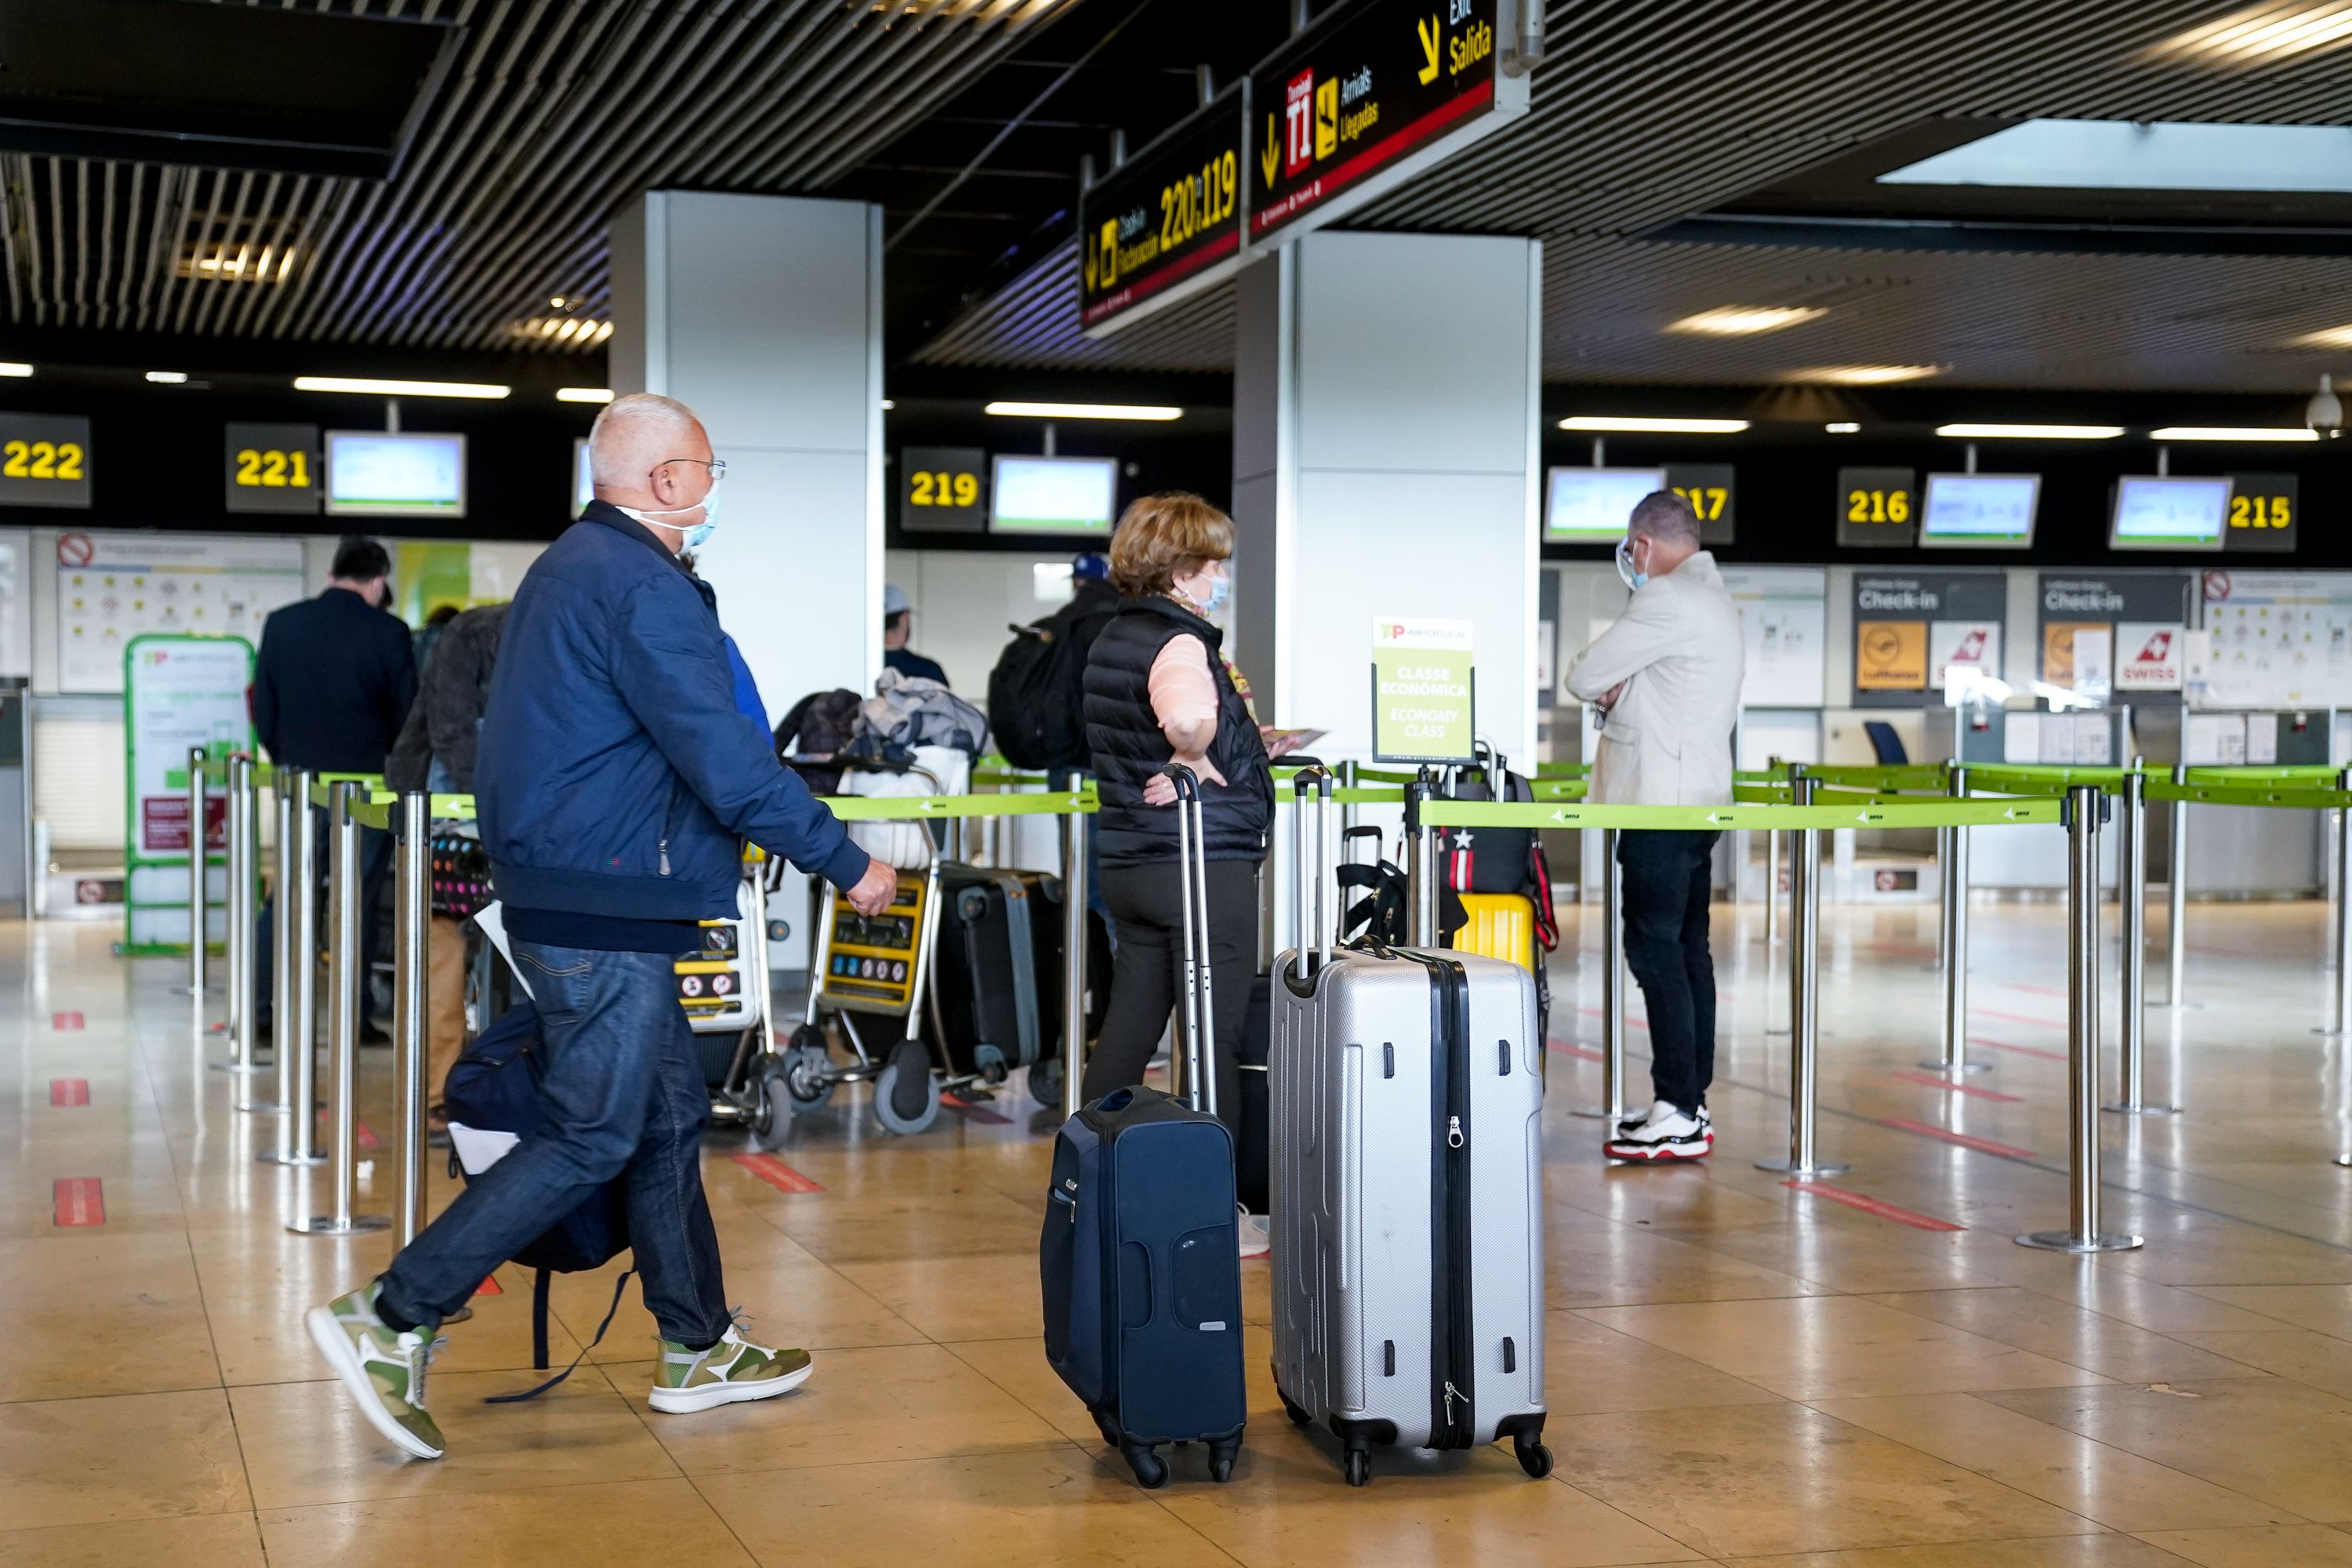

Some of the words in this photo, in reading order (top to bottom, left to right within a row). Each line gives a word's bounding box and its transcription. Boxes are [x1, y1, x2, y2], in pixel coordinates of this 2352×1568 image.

[1449, 19, 1491, 76] Salida
[1287, 94, 1312, 166] T1
[1340, 100, 1378, 142] Llegadas
[1160, 173, 1196, 252] 220
[1202, 149, 1236, 227] 119
[3, 440, 84, 481] 222
[236, 449, 311, 488] 221
[910, 470, 978, 507] 219
[1673, 487, 1728, 520] 17
[1847, 489, 1909, 524] 216
[2230, 495, 2291, 529] 215
[1380, 681, 1468, 698] ECONÓMICA
[1397, 666, 1450, 681] CLASSE
[1390, 708, 1459, 724] ECONOMY
[1404, 724, 1445, 739] CLASS
